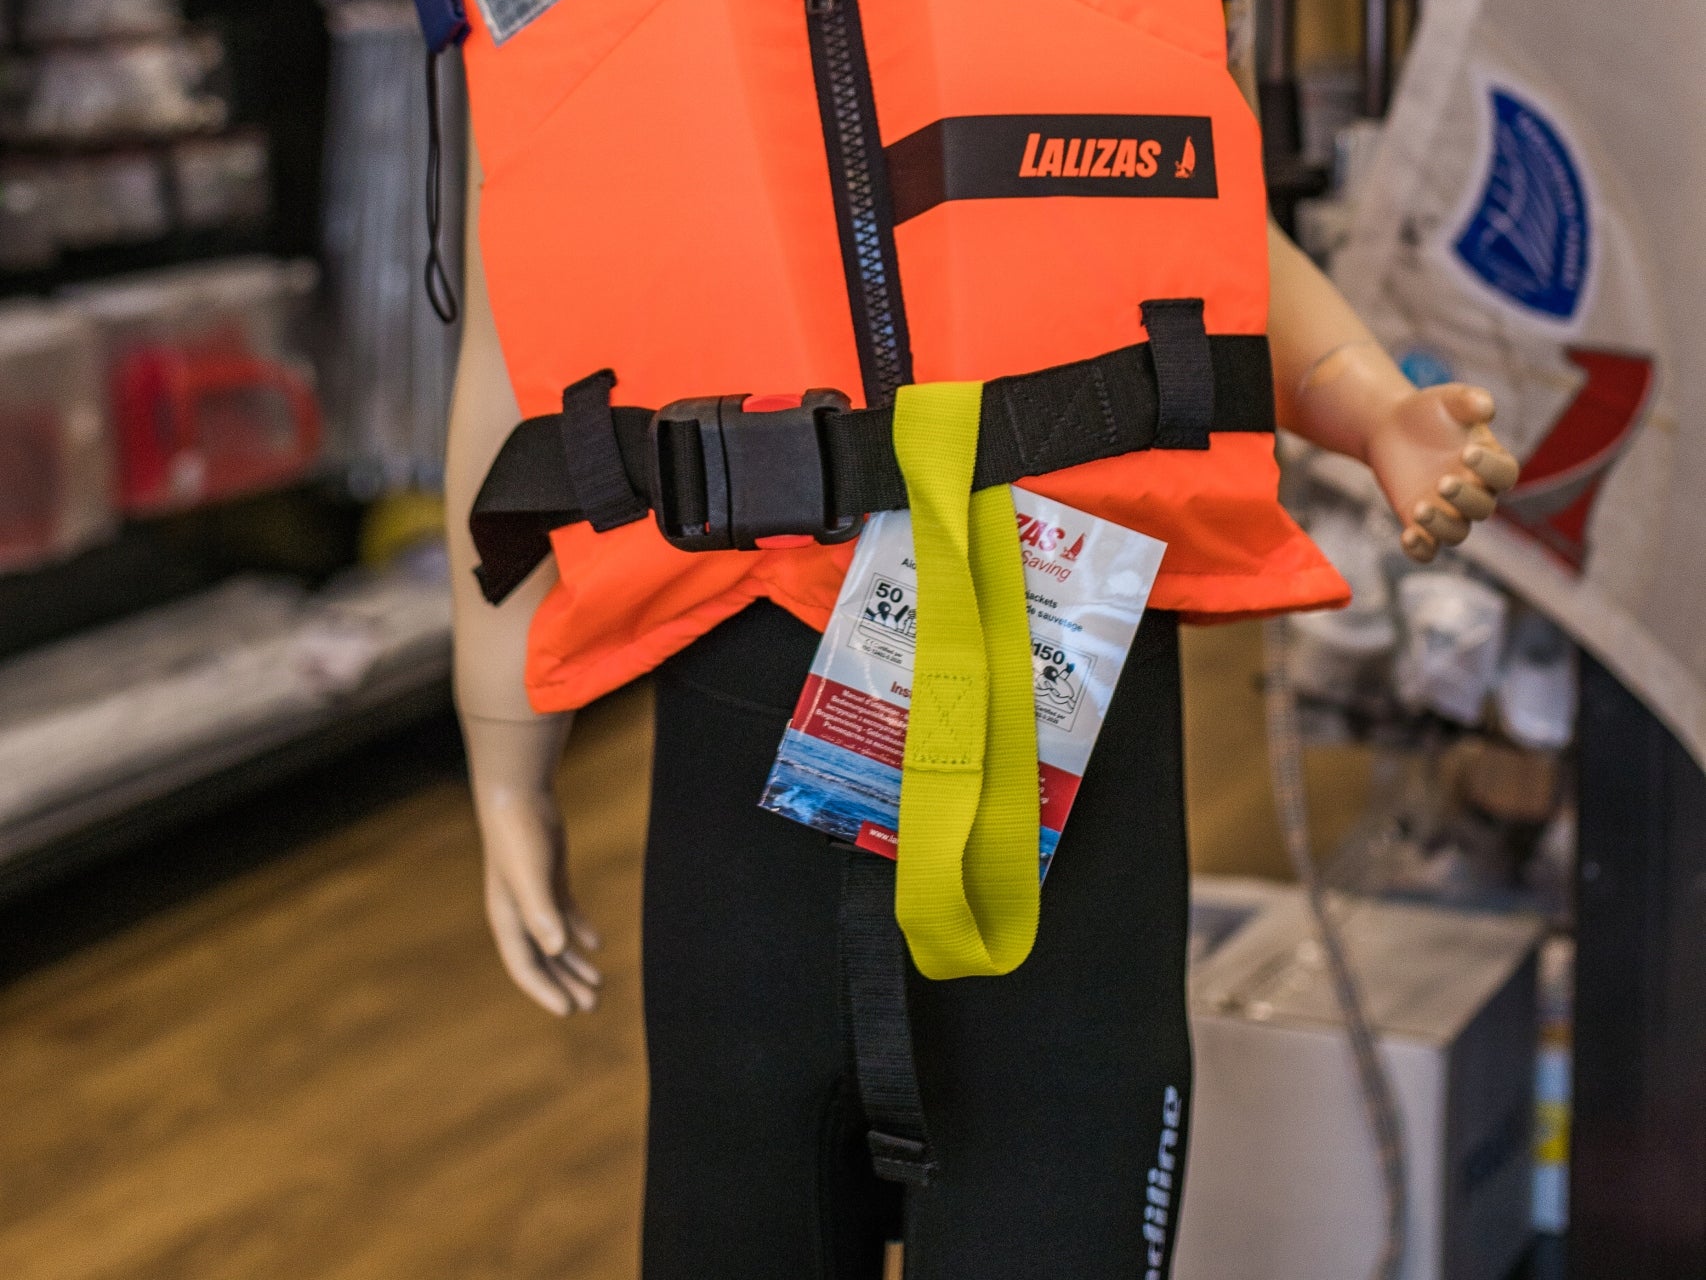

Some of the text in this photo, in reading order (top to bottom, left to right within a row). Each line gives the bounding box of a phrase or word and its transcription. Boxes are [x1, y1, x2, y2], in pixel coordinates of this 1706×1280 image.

[1018, 132, 1162, 179] LALIZAS
[876, 582, 903, 604] 50
[1037, 609, 1083, 632] sauvetage
[1032, 640, 1065, 666] 150
